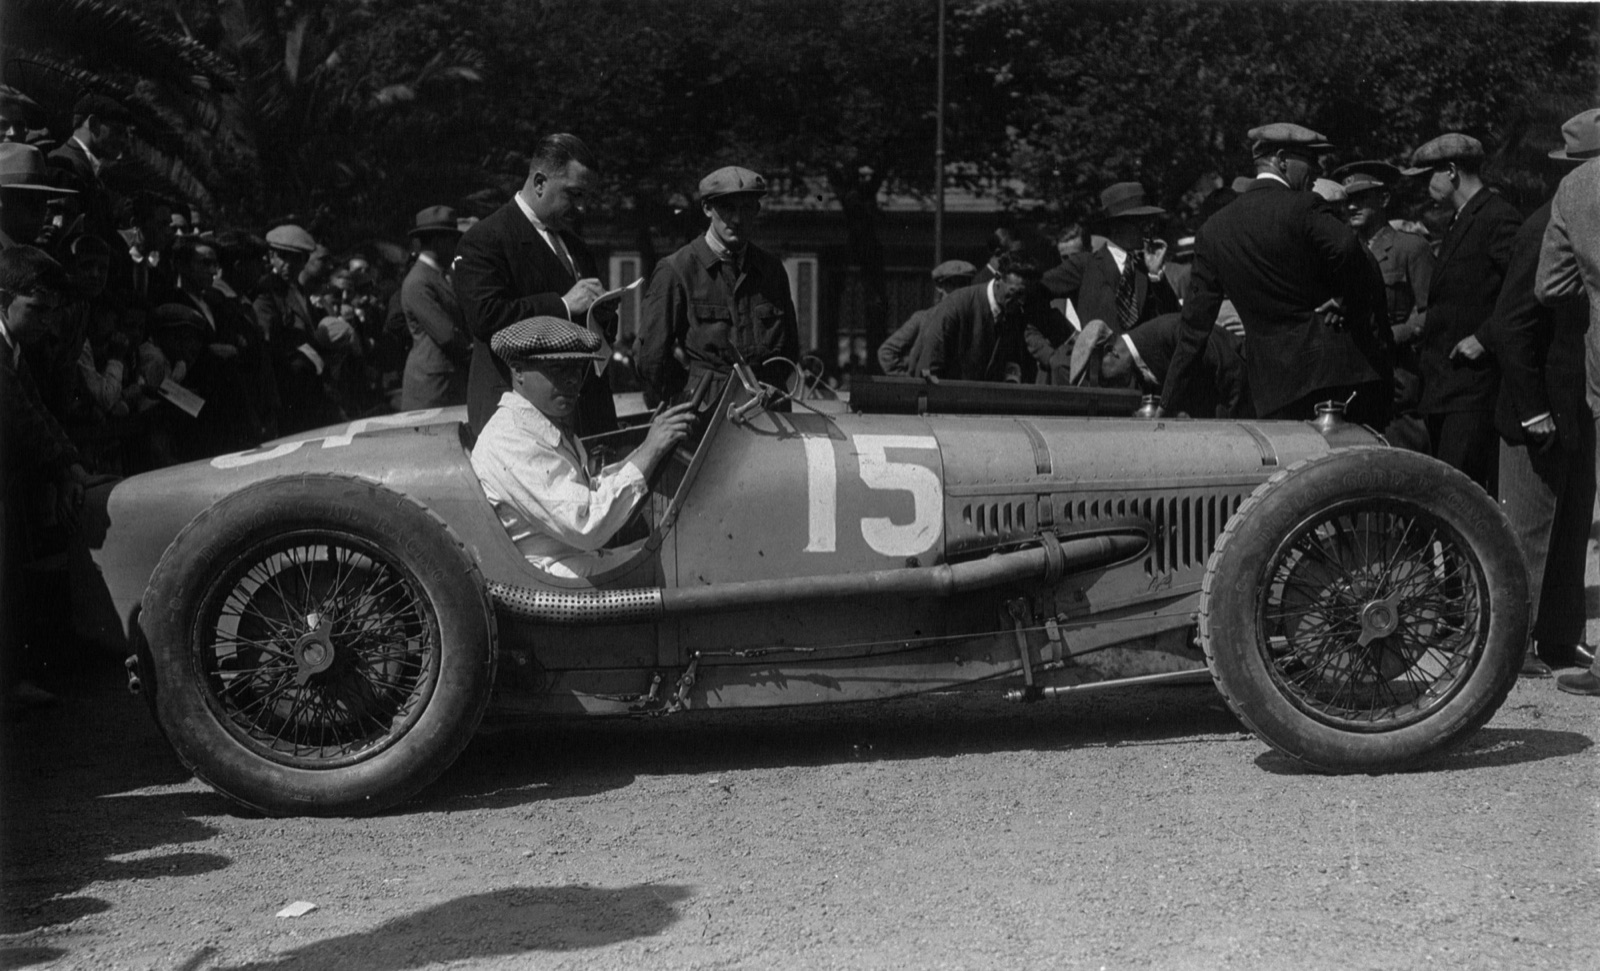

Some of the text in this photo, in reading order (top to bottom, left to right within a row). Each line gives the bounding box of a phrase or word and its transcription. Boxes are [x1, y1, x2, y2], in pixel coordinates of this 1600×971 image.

[803, 433, 943, 557] 15
[1417, 475, 1491, 537] RCING
[296, 500, 363, 523] CORD
[373, 515, 449, 584] RACING
